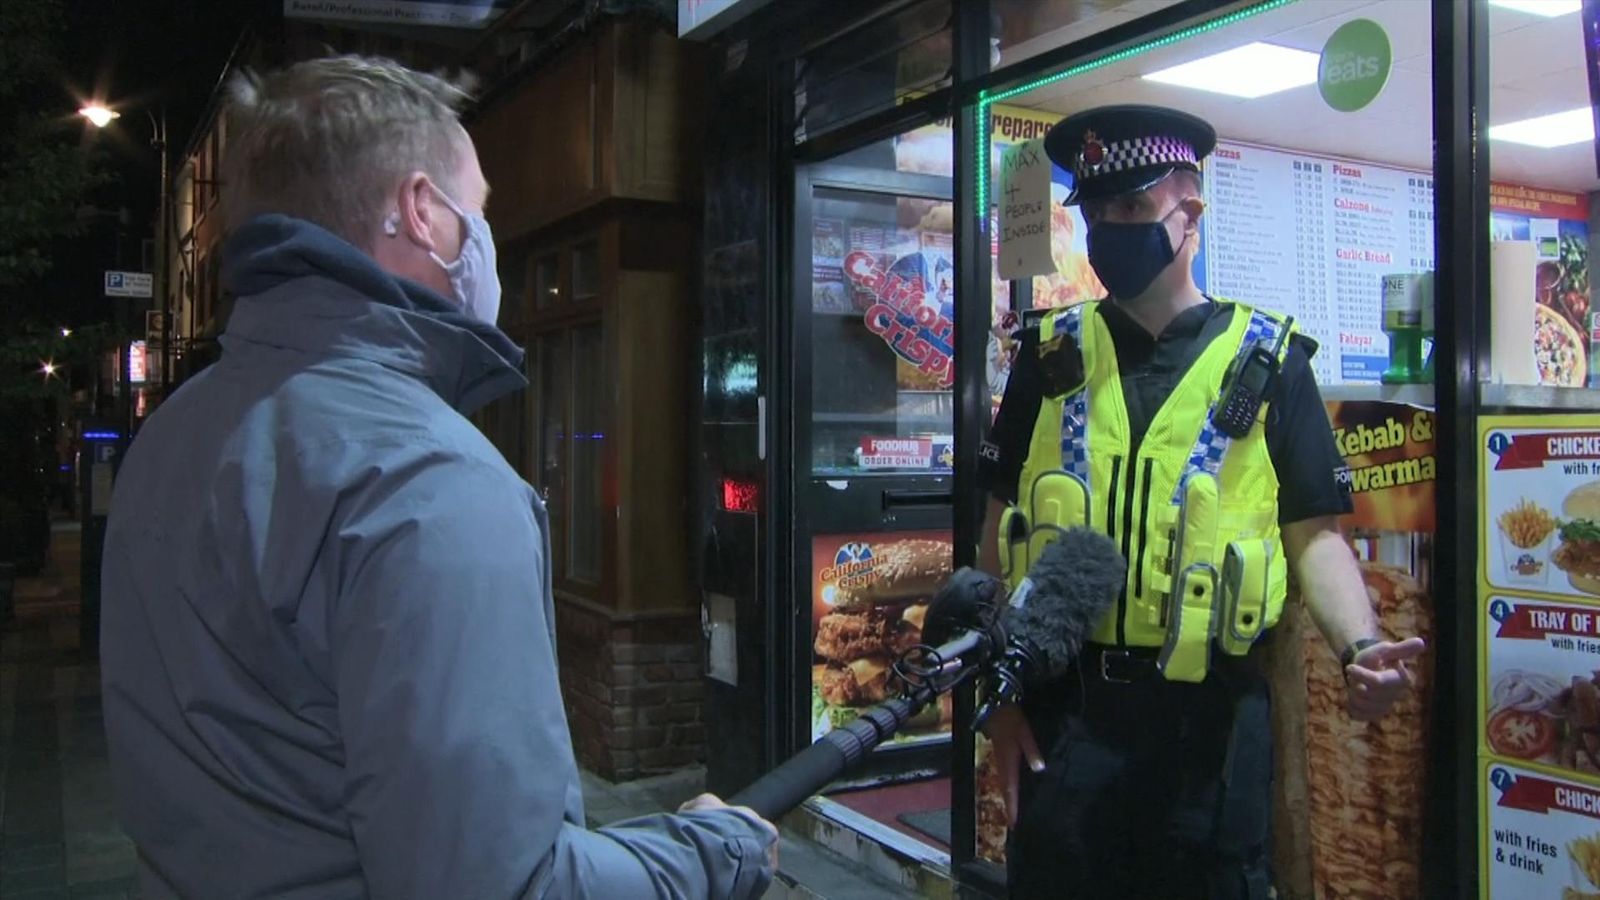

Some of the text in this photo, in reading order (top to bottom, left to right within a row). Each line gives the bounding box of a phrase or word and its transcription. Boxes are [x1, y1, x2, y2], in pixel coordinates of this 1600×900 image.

[1327, 55, 1379, 84] eats
[1004, 149, 1040, 174] MAX
[1214, 149, 1240, 160] izzas
[1333, 164, 1362, 178] Pizzas
[1003, 221, 1046, 243] INSIDE
[1336, 248, 1391, 265] Garlic Bread
[110, 275, 121, 287] P
[1332, 411, 1433, 456] Kebab &
[870, 439, 920, 455] FOODHUB
[863, 457, 925, 466] ORDER ONLINE
[1563, 462, 1588, 475] with
[1350, 455, 1436, 493] warma
[819, 554, 889, 582] California
[1528, 610, 1566, 630] TRAY
[1571, 612, 1591, 632] OF
[1551, 639, 1574, 650] with
[1495, 829, 1558, 858] with fries
[1496, 847, 1544, 875] & drink
